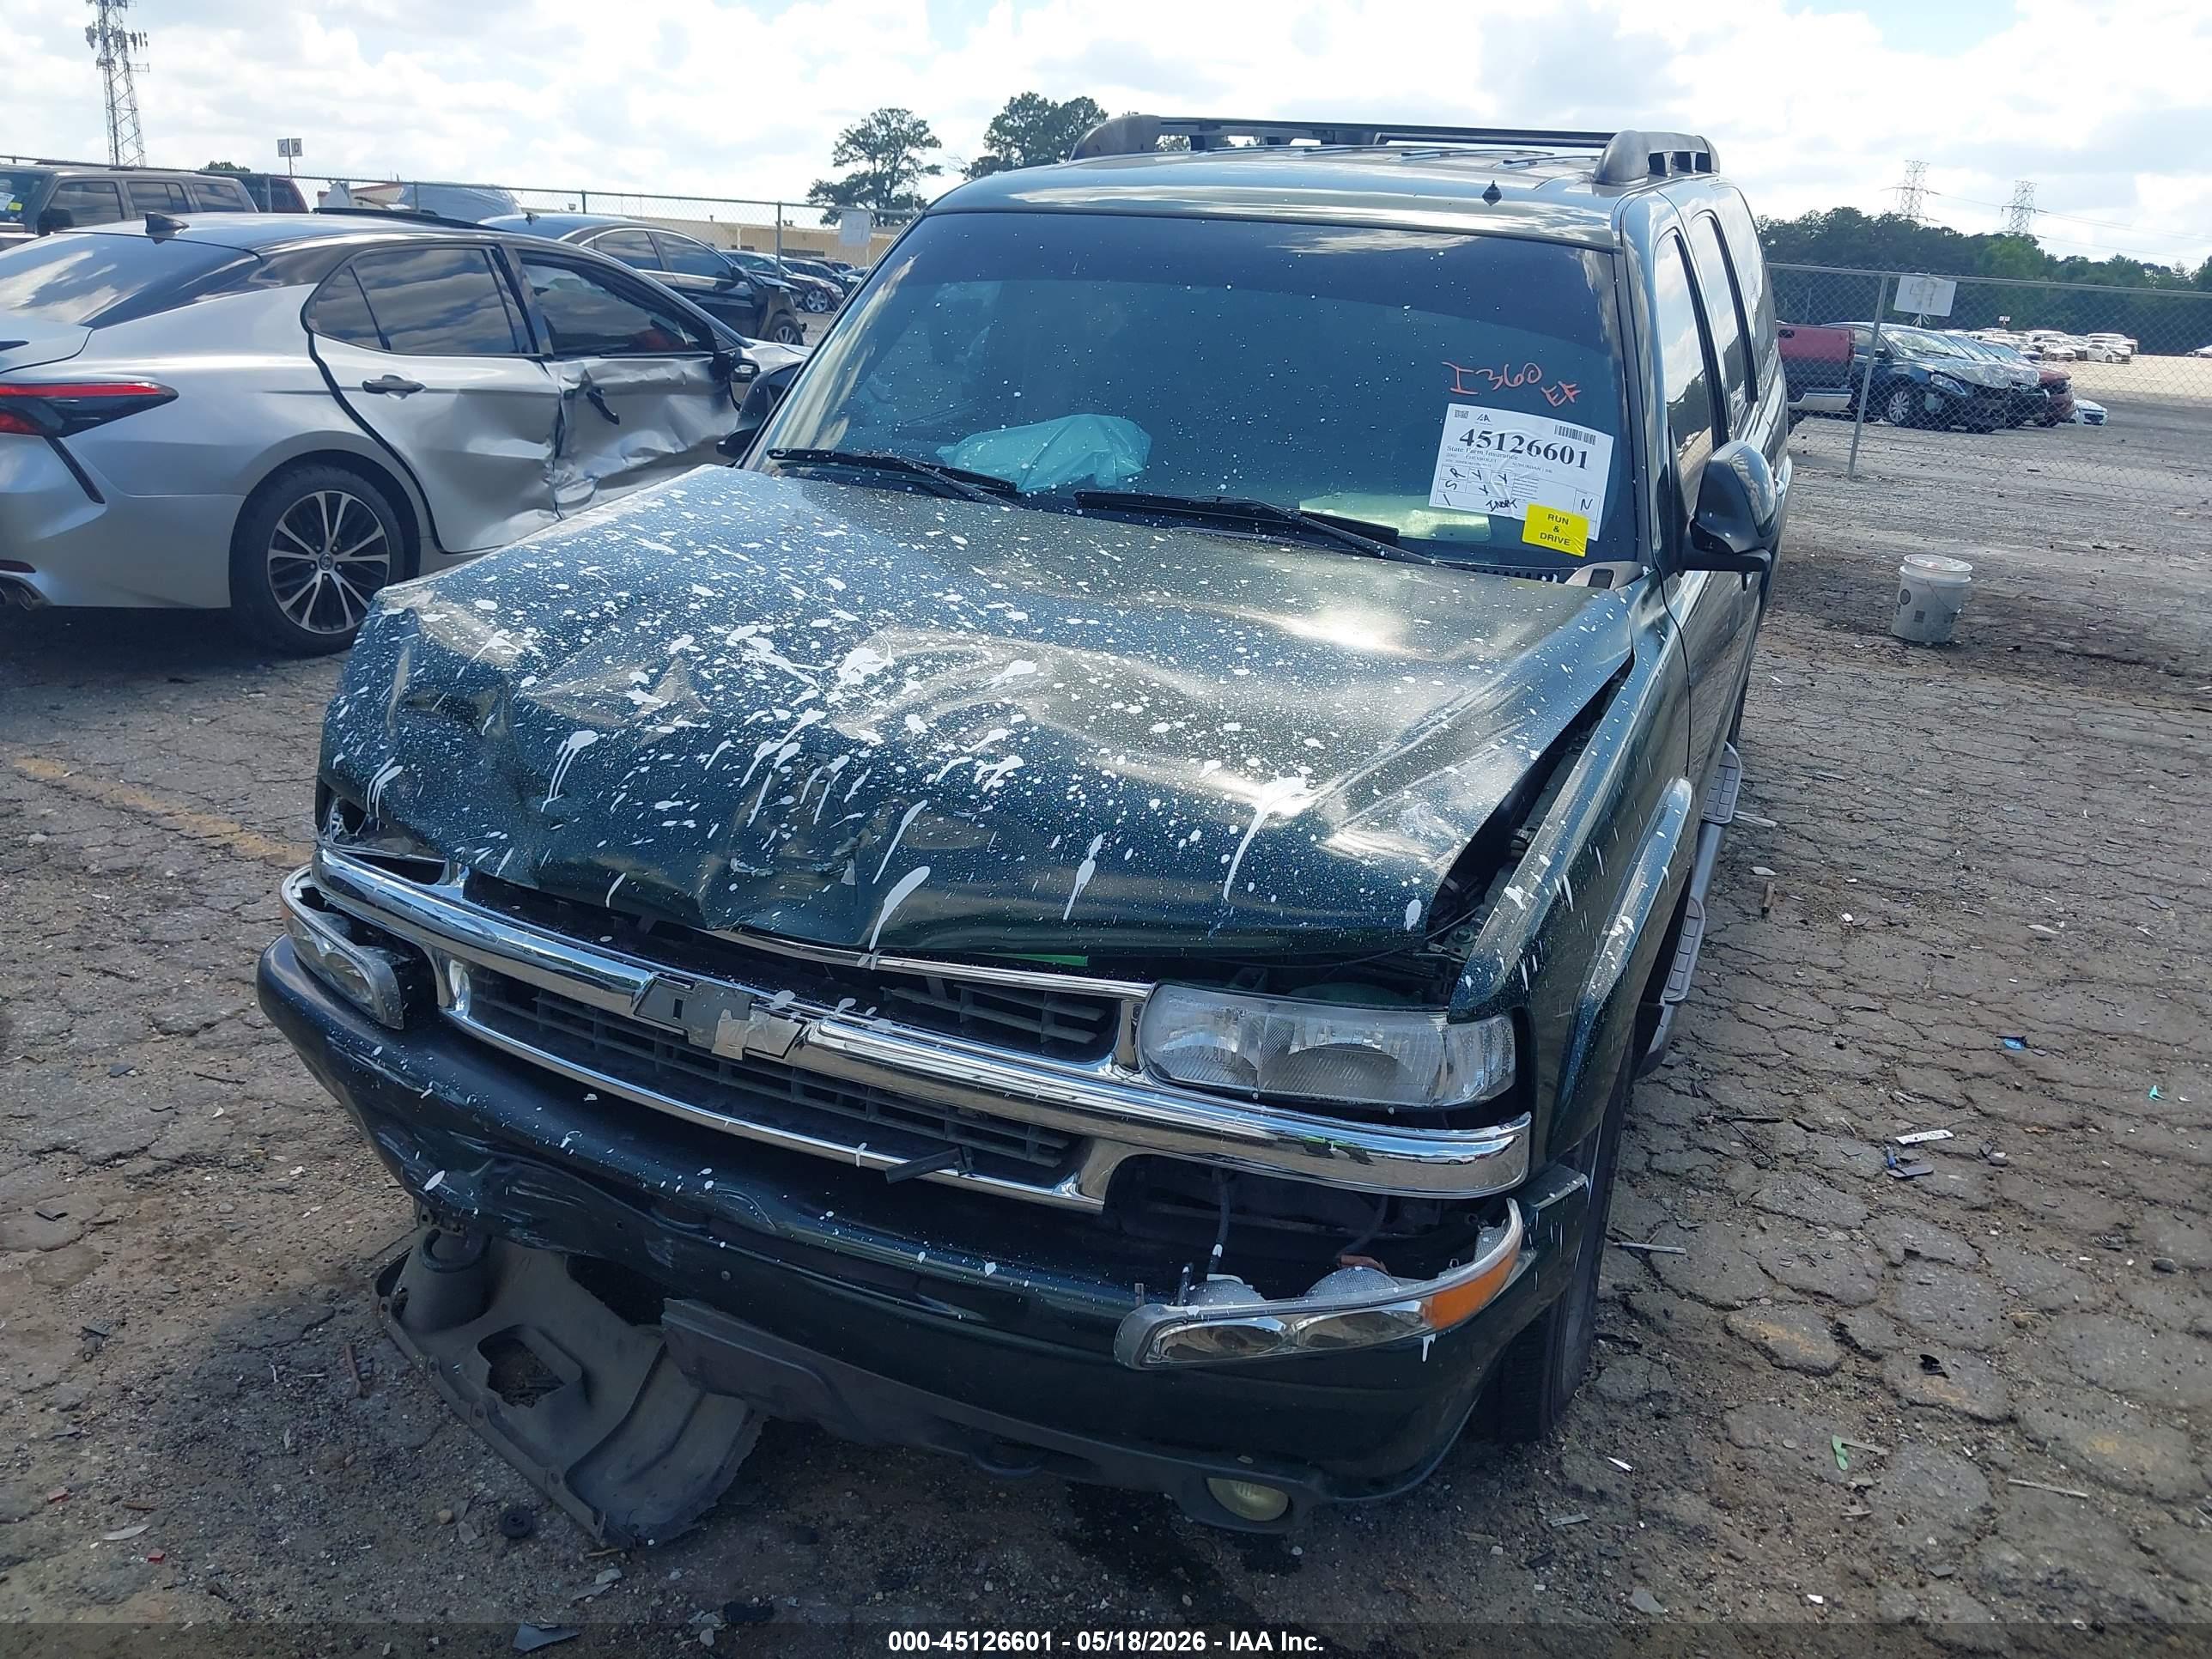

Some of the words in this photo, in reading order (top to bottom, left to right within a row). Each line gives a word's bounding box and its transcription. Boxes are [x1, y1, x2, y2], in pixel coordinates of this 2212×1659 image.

[1447, 445, 1465, 453] State
[1466, 447, 1485, 456] Farm
[1486, 450, 1519, 461] Insurance
[1459, 428, 1589, 471] 45126601
[1449, 467, 1467, 478] R
[1579, 497, 1595, 511] N
[1547, 514, 1570, 526] RUN
[1540, 532, 1571, 546] DRIVE
